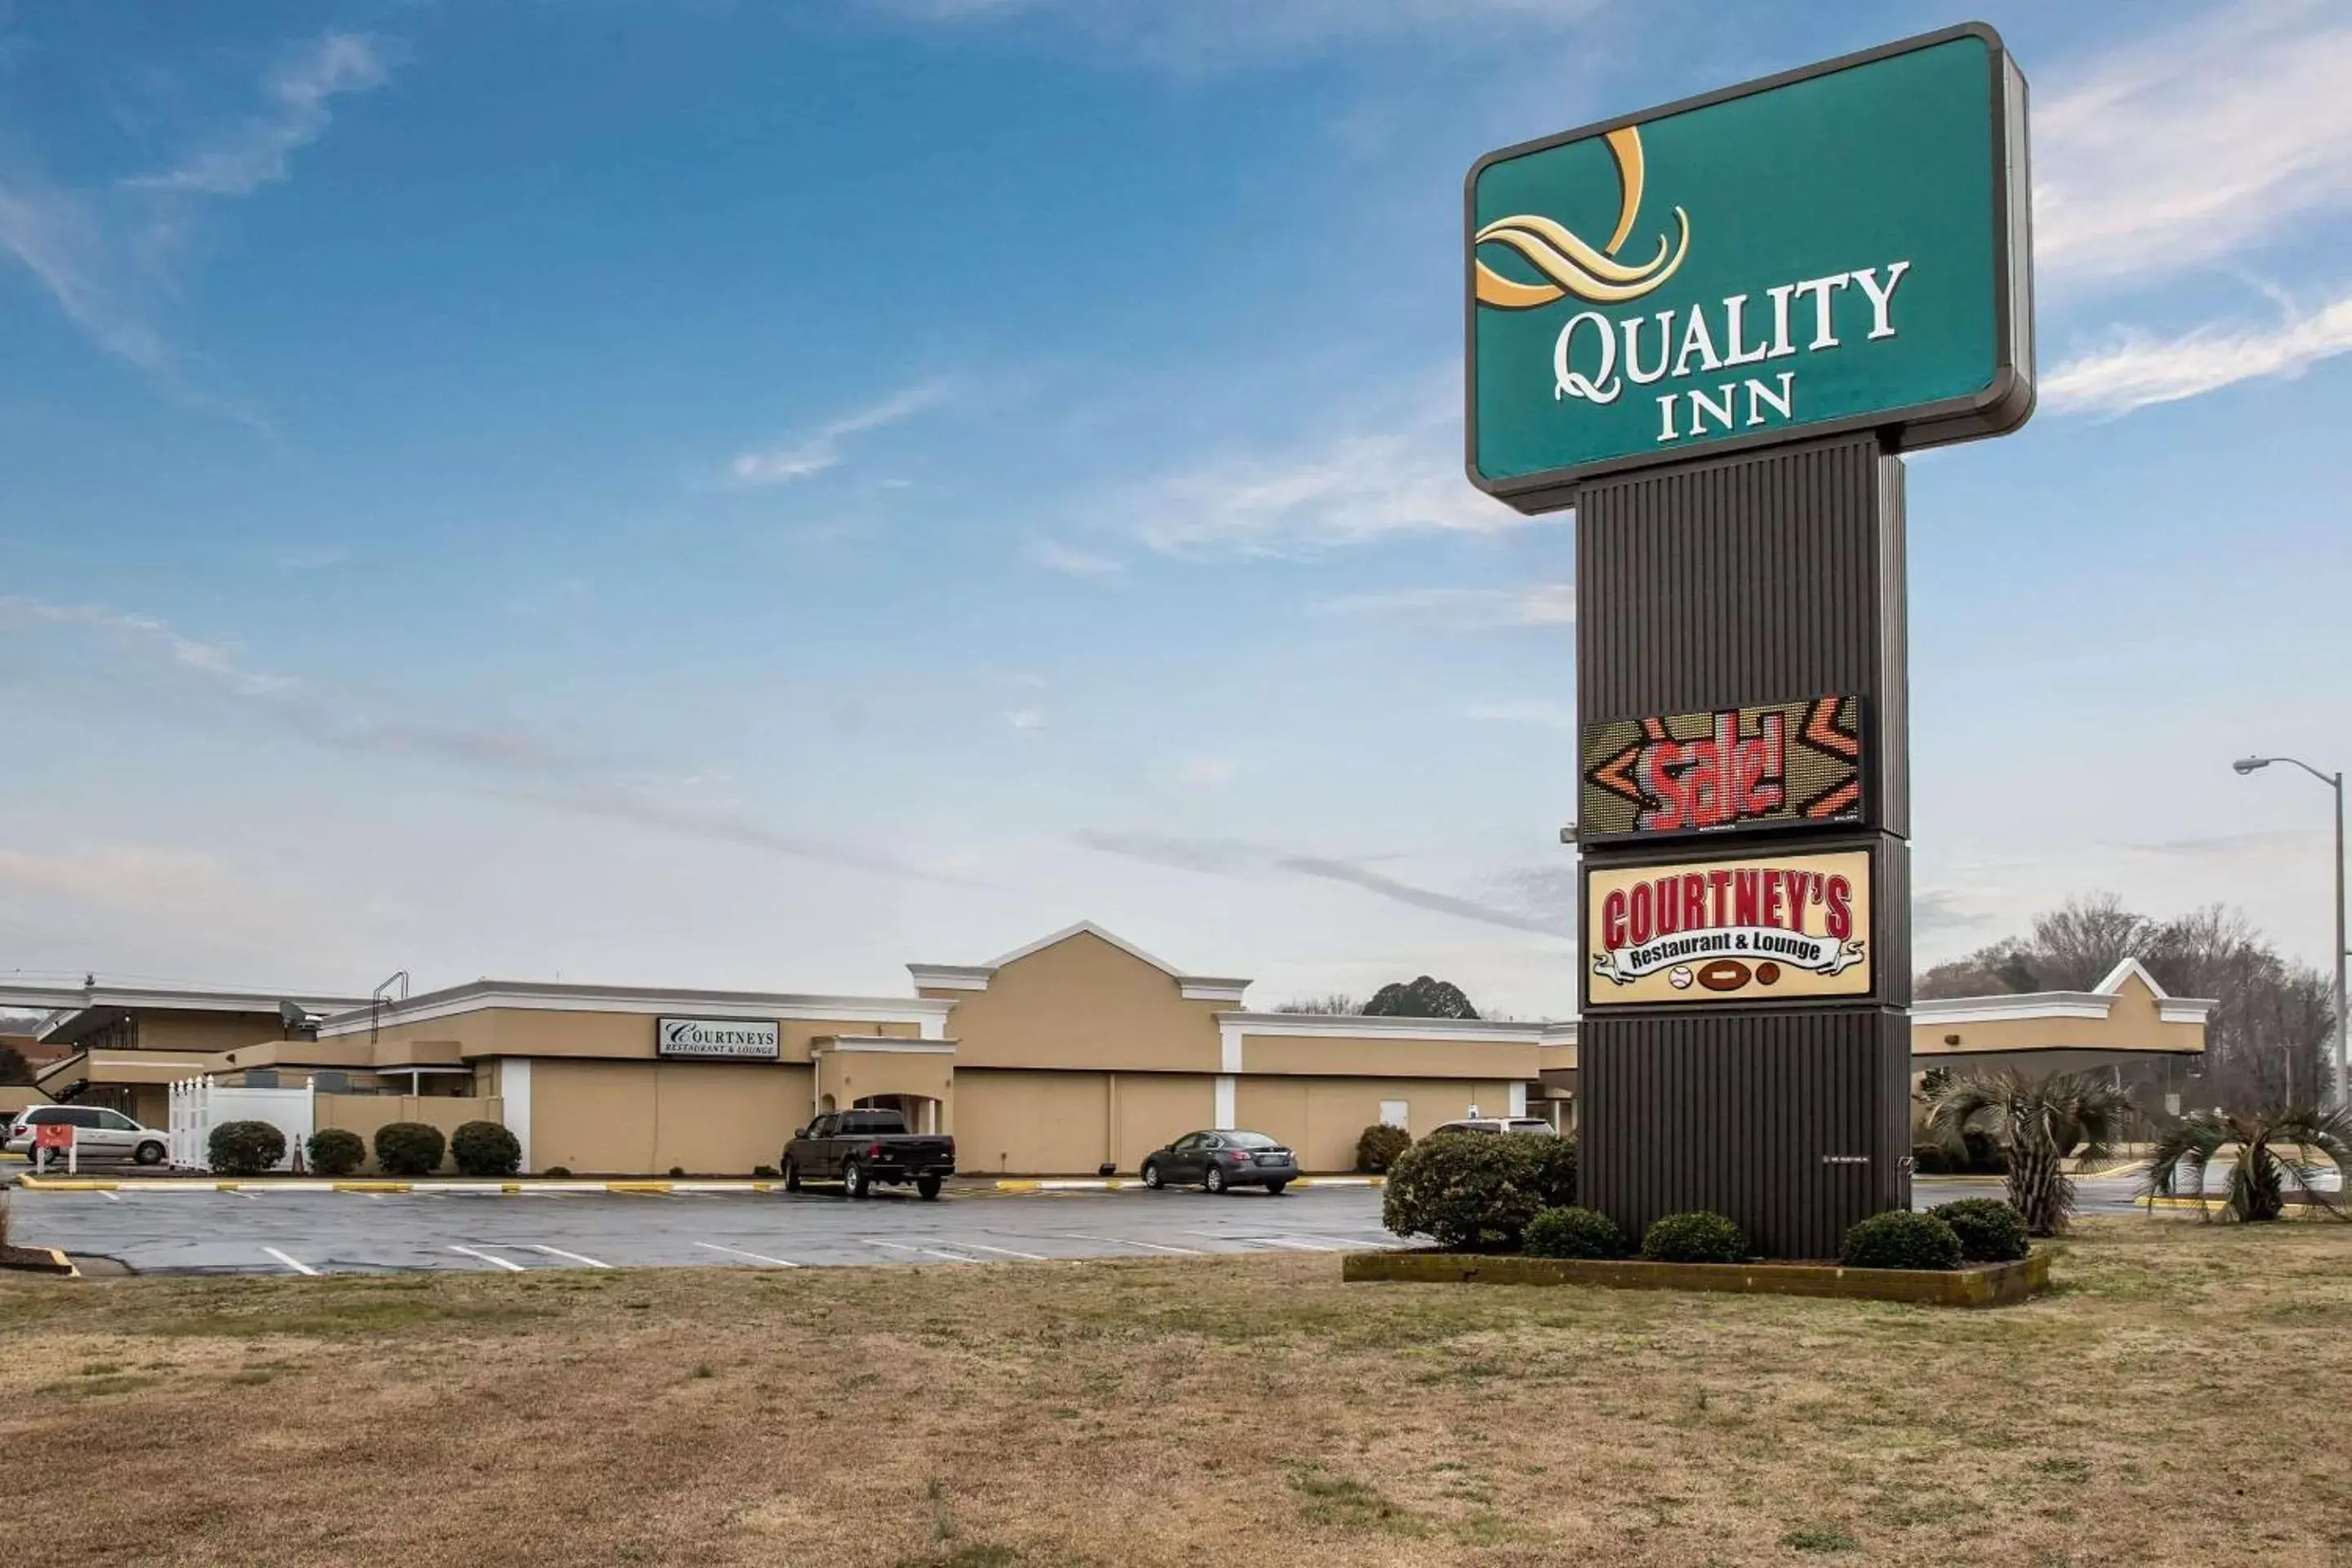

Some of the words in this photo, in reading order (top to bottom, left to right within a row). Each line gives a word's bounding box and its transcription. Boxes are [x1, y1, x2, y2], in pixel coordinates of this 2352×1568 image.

[1554, 261, 1911, 403] QUALITY
[1655, 372, 1796, 442] INN
[1602, 869, 1852, 952] COURTNEY'S
[1630, 933, 1731, 970] Restaurant
[1735, 935, 1749, 949] &
[1753, 932, 1822, 961] Lounge
[666, 1044, 724, 1054] RESTAURANT
[737, 1045, 774, 1054] LOUNGE
